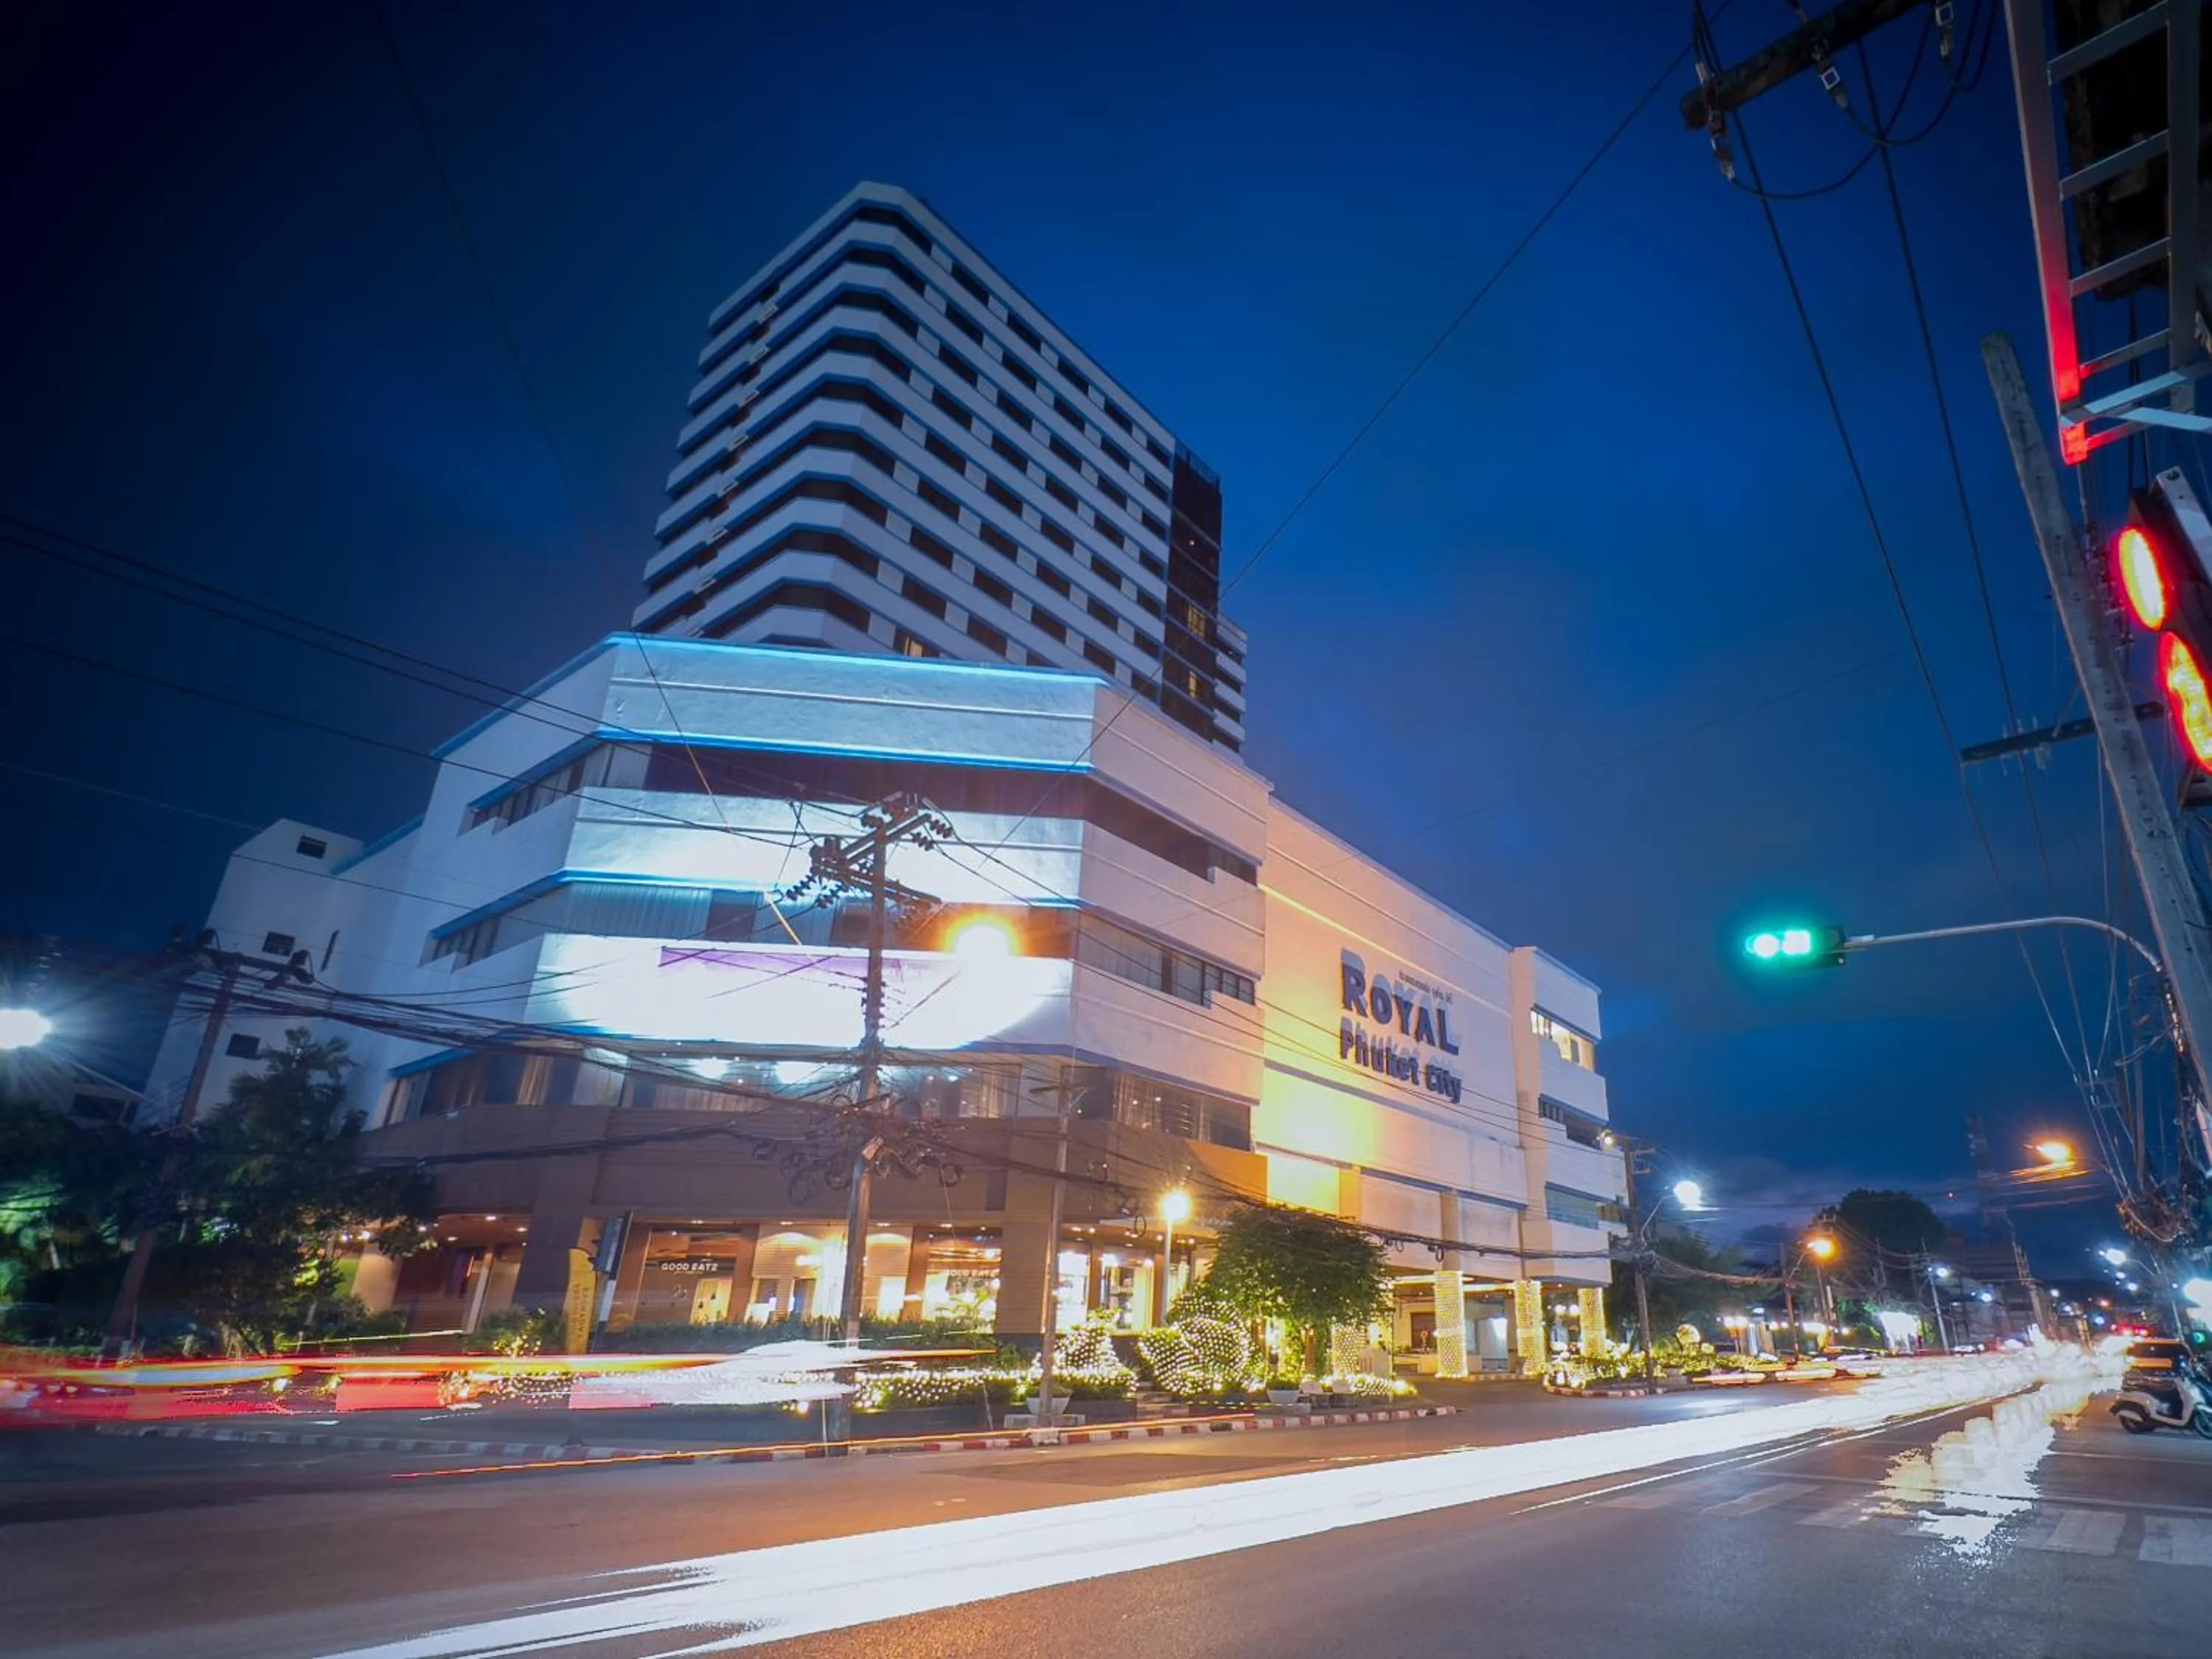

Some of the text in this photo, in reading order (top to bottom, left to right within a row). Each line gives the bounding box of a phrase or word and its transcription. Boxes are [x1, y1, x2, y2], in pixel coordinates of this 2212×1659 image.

[1340, 947, 1461, 1056] ROYAL
[1340, 1016, 1419, 1086] Phuket
[661, 1262, 689, 1271] GOOD
